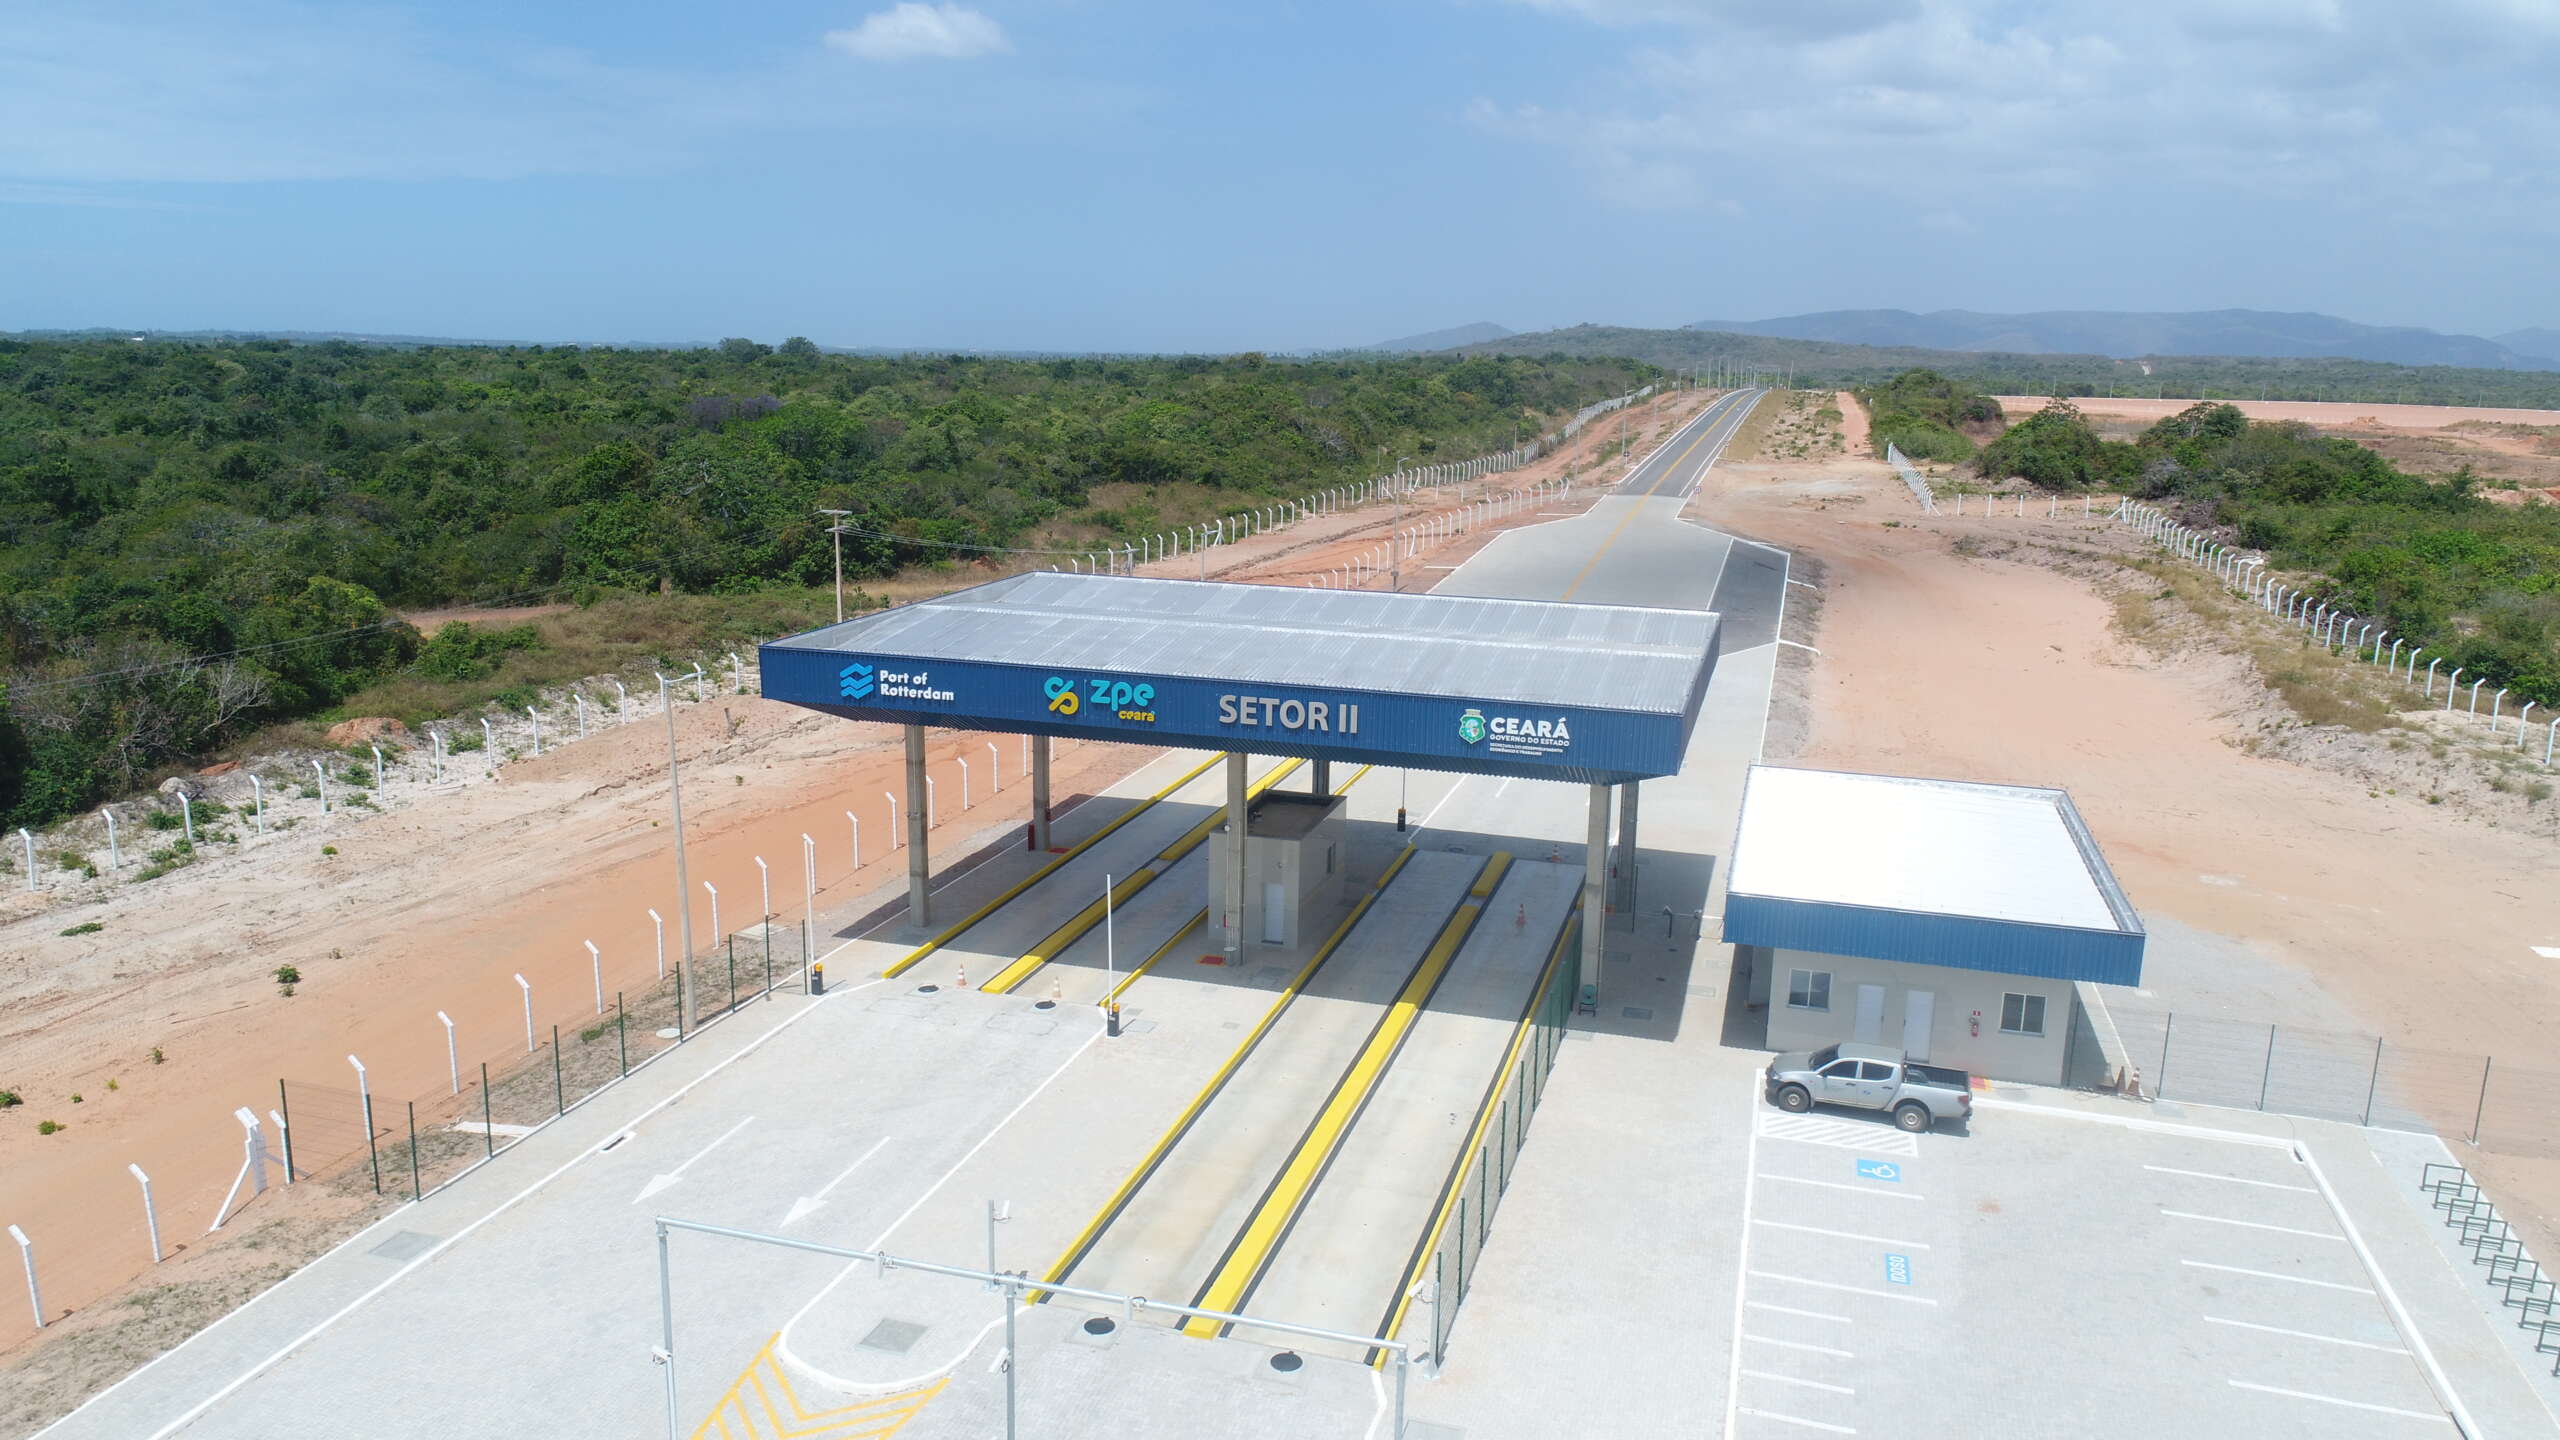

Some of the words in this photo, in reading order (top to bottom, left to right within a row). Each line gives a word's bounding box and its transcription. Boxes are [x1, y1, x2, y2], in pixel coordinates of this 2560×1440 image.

[880, 670, 909, 684] Port
[913, 672, 928, 685] of
[880, 684, 954, 700] Rotterdam
[1219, 695, 1329, 732] SETOR
[1339, 704, 1358, 734] II
[1490, 717, 1570, 739] CEARÁ
[1490, 734, 1526, 743] GOVERNO
[1527, 737, 1539, 745] DO
[1540, 738, 1570, 747] ESTADO
